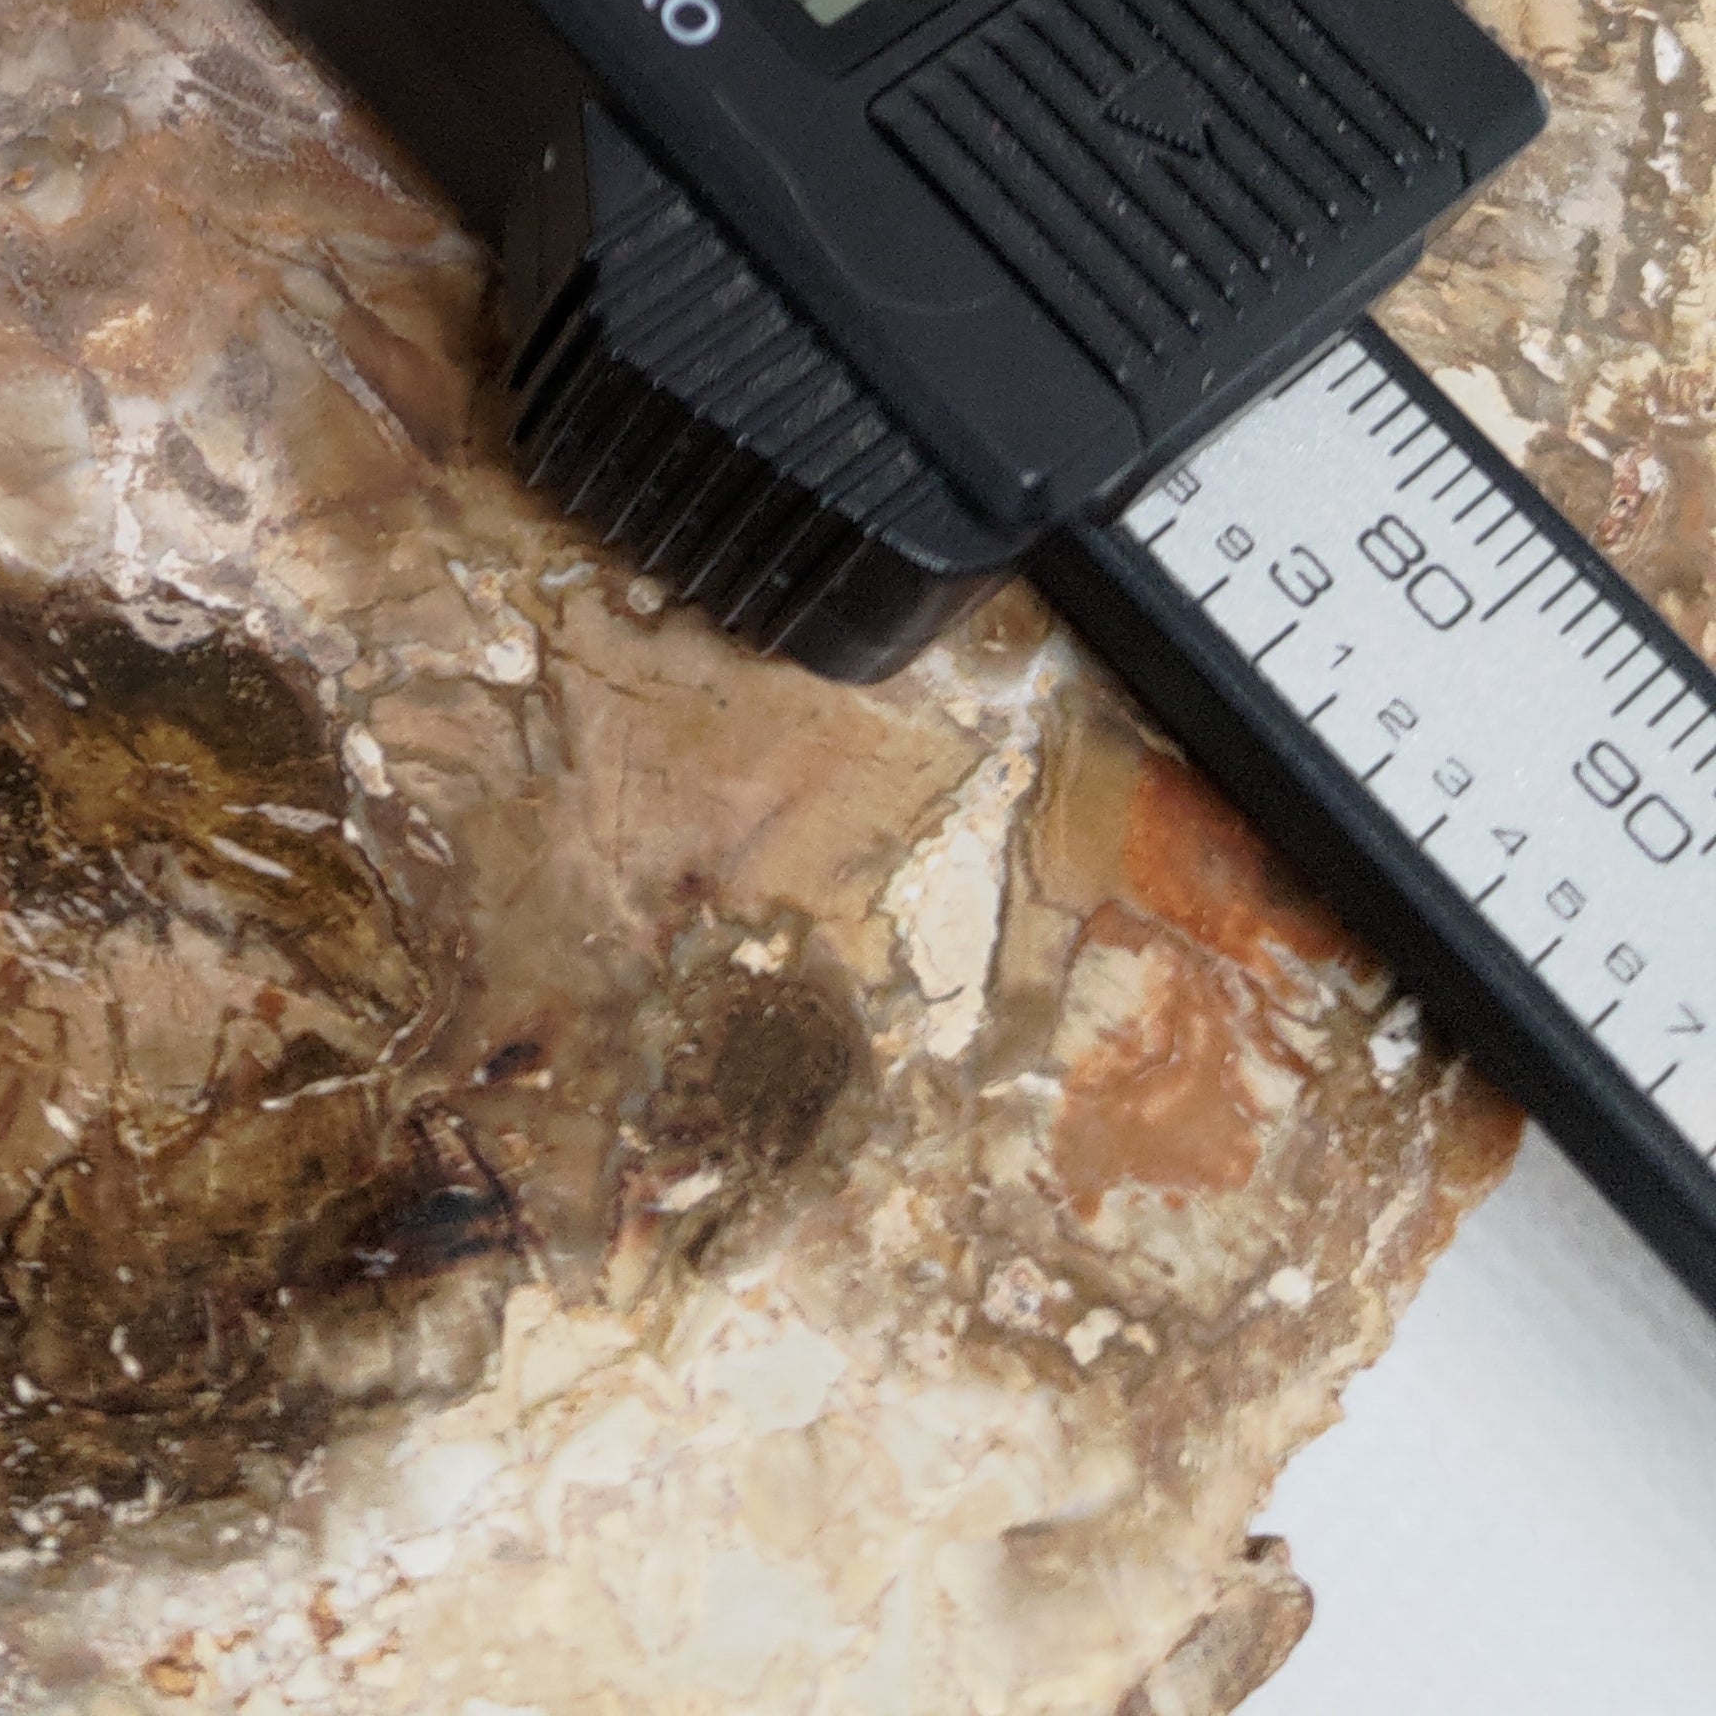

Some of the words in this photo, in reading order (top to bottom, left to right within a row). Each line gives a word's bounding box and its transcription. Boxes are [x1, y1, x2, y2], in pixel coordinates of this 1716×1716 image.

[1268, 545, 1335, 608] 3
[1326, 641, 1356, 669] 1
[1377, 698, 1419, 738] 2
[1432, 758, 1473, 799] 3
[1491, 822, 1529, 859] 4
[1665, 1003, 1707, 1041] 7
[1357, 513, 1474, 631] 80
[1572, 740, 1693, 865] 90
